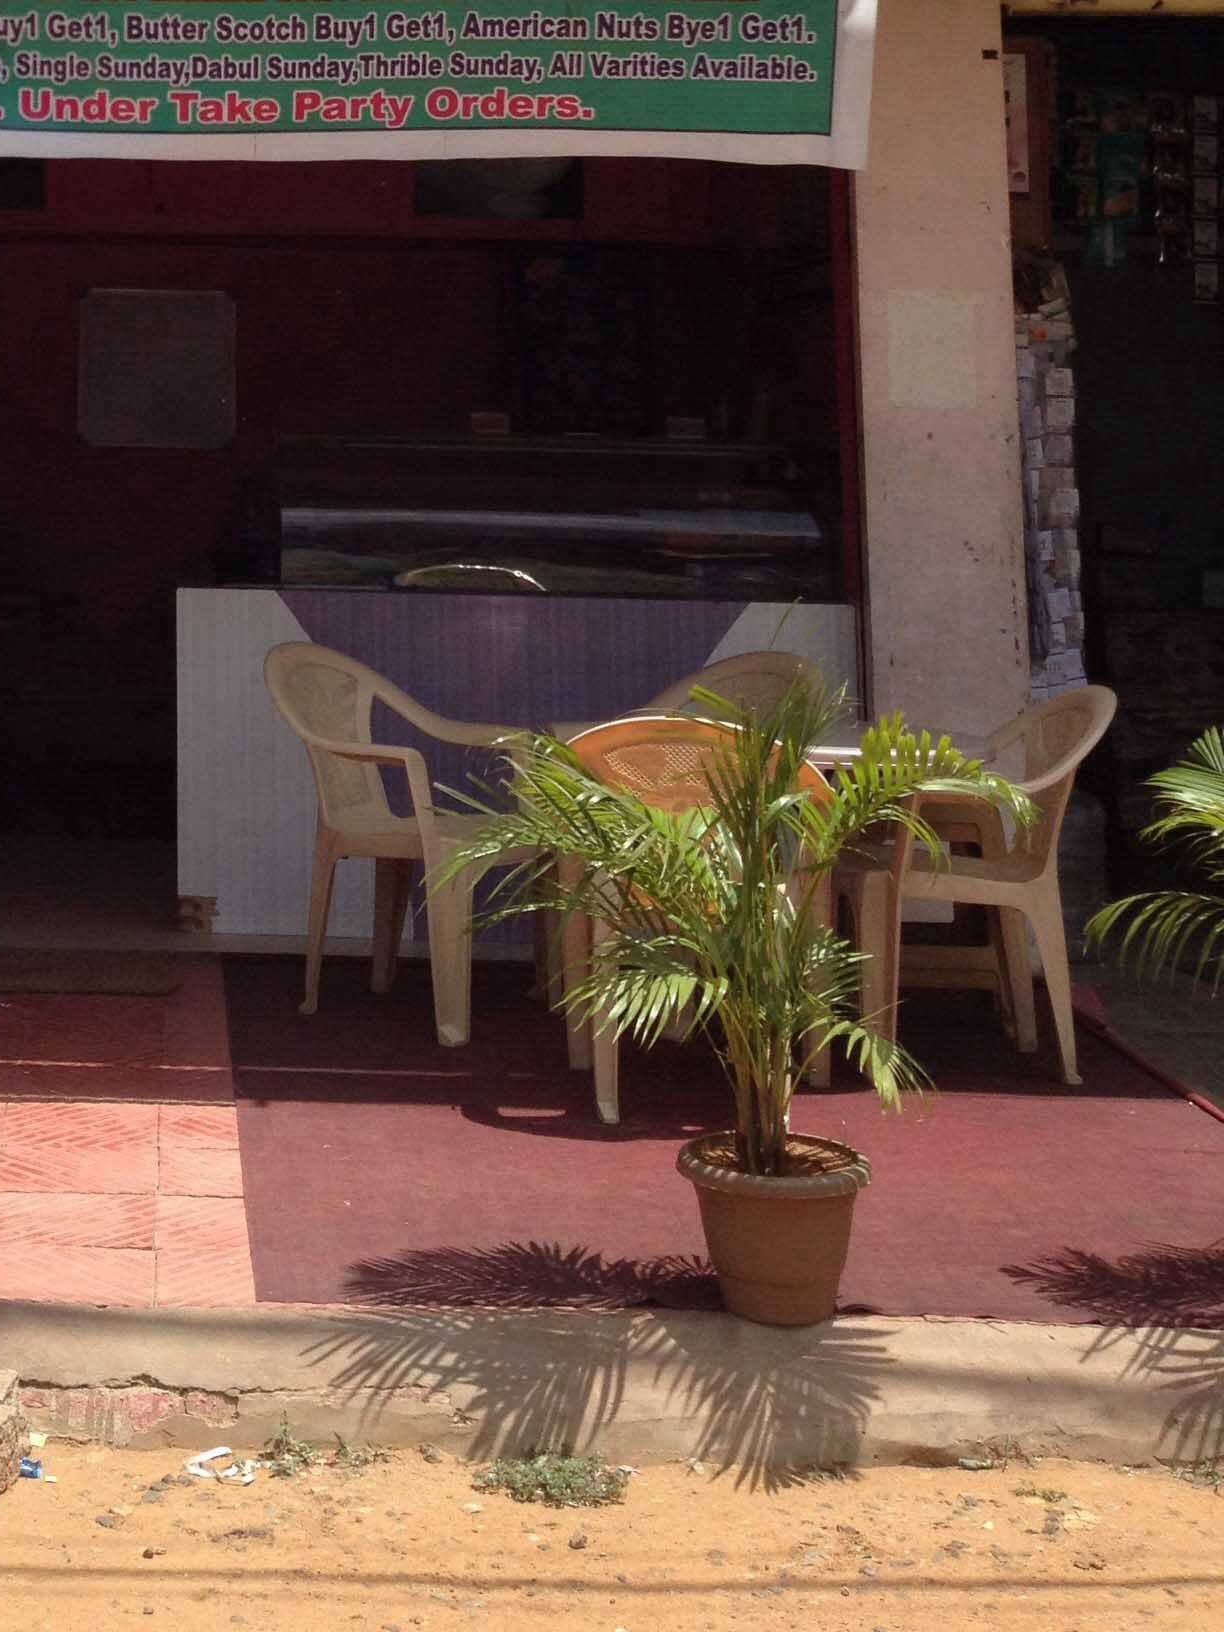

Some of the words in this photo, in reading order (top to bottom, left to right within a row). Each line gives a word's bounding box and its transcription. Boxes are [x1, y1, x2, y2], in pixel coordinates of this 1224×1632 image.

[47, 13, 117, 48] Get1,
[126, 13, 209, 43] Butter
[215, 13, 307, 43] Scotch
[313, 13, 377, 47] Buy1
[385, 12, 456, 45] Get1,
[461, 11, 590, 41] American
[594, 11, 659, 42] Nuts
[665, 13, 731, 47] Bye1
[740, 14, 817, 43] Get1.
[14, 53, 90, 82] Single
[448, 52, 544, 83] Sunday,
[549, 53, 587, 78] All
[590, 53, 685, 80] Varities
[690, 53, 817, 82] Available.
[19, 89, 158, 123] Under
[168, 90, 279, 124] Take
[293, 89, 413, 127] Party
[425, 88, 594, 120] Orders.
